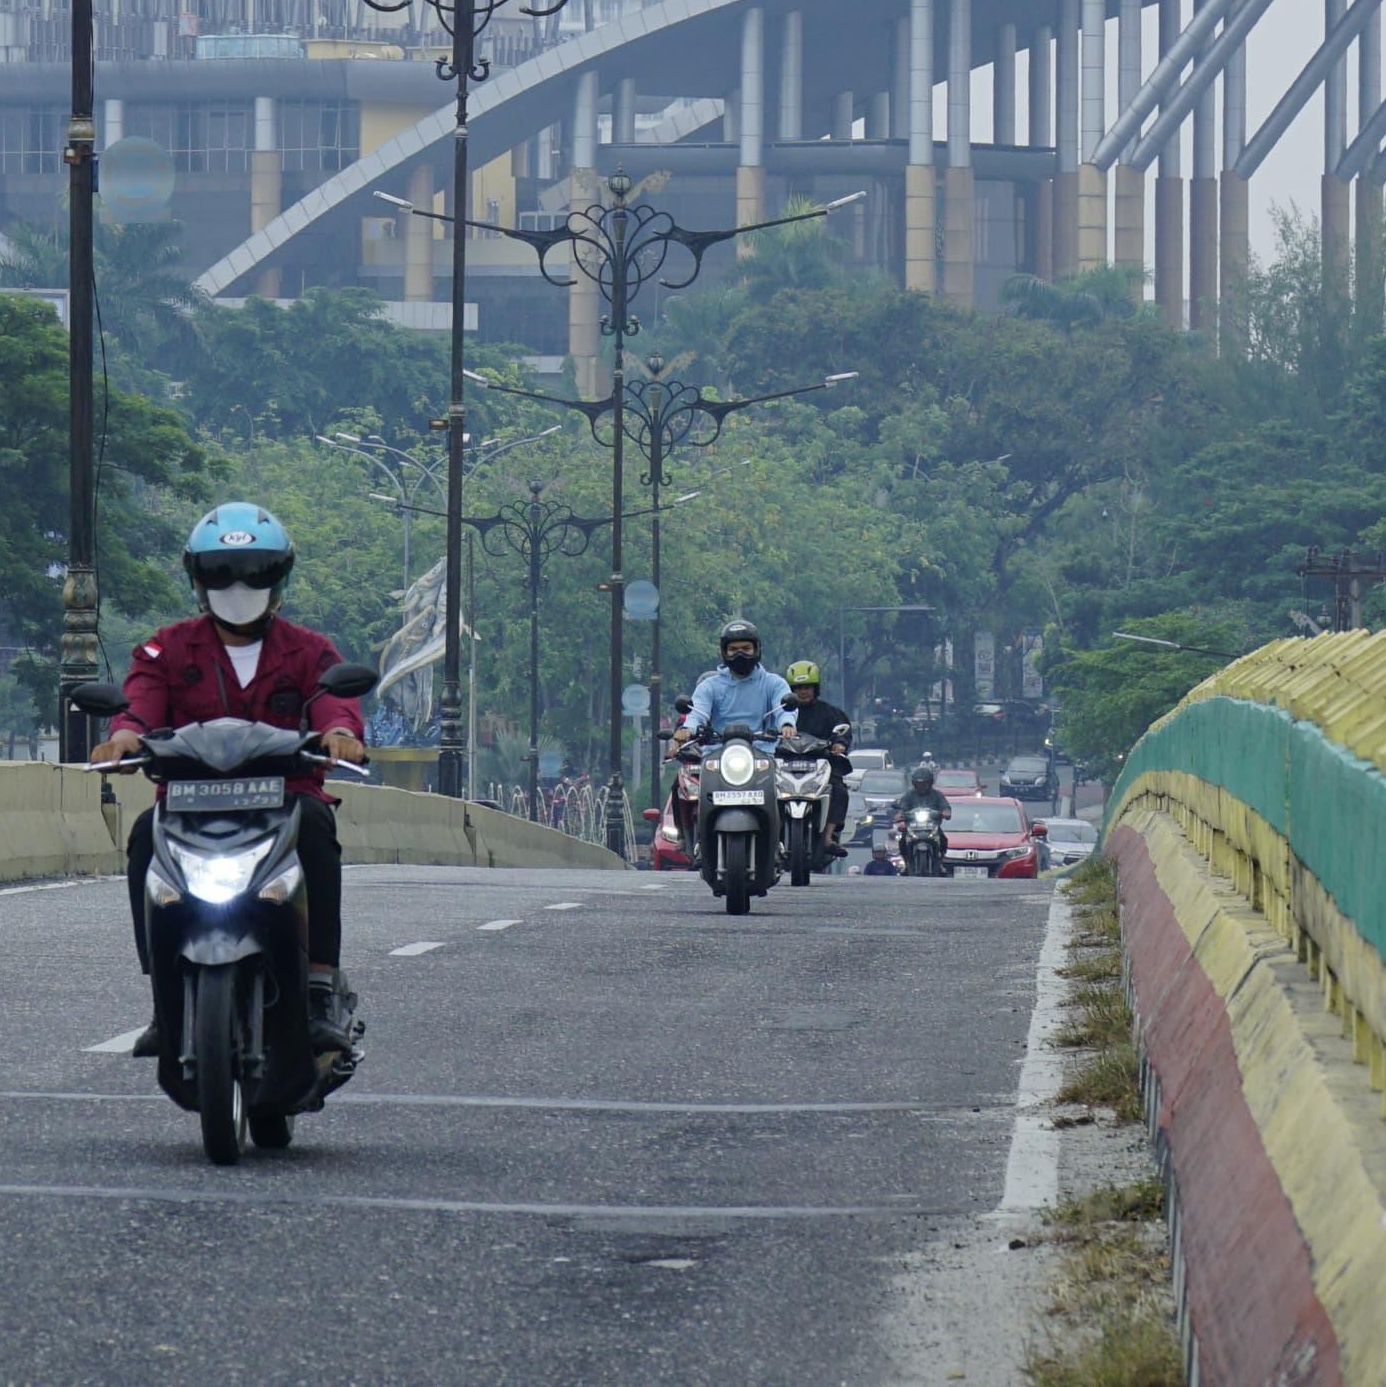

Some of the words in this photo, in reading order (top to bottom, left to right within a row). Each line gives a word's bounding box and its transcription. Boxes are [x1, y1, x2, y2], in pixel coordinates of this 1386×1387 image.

[172, 784, 195, 797] BM
[199, 783, 244, 796] 3058
[248, 781, 280, 794] AAE
